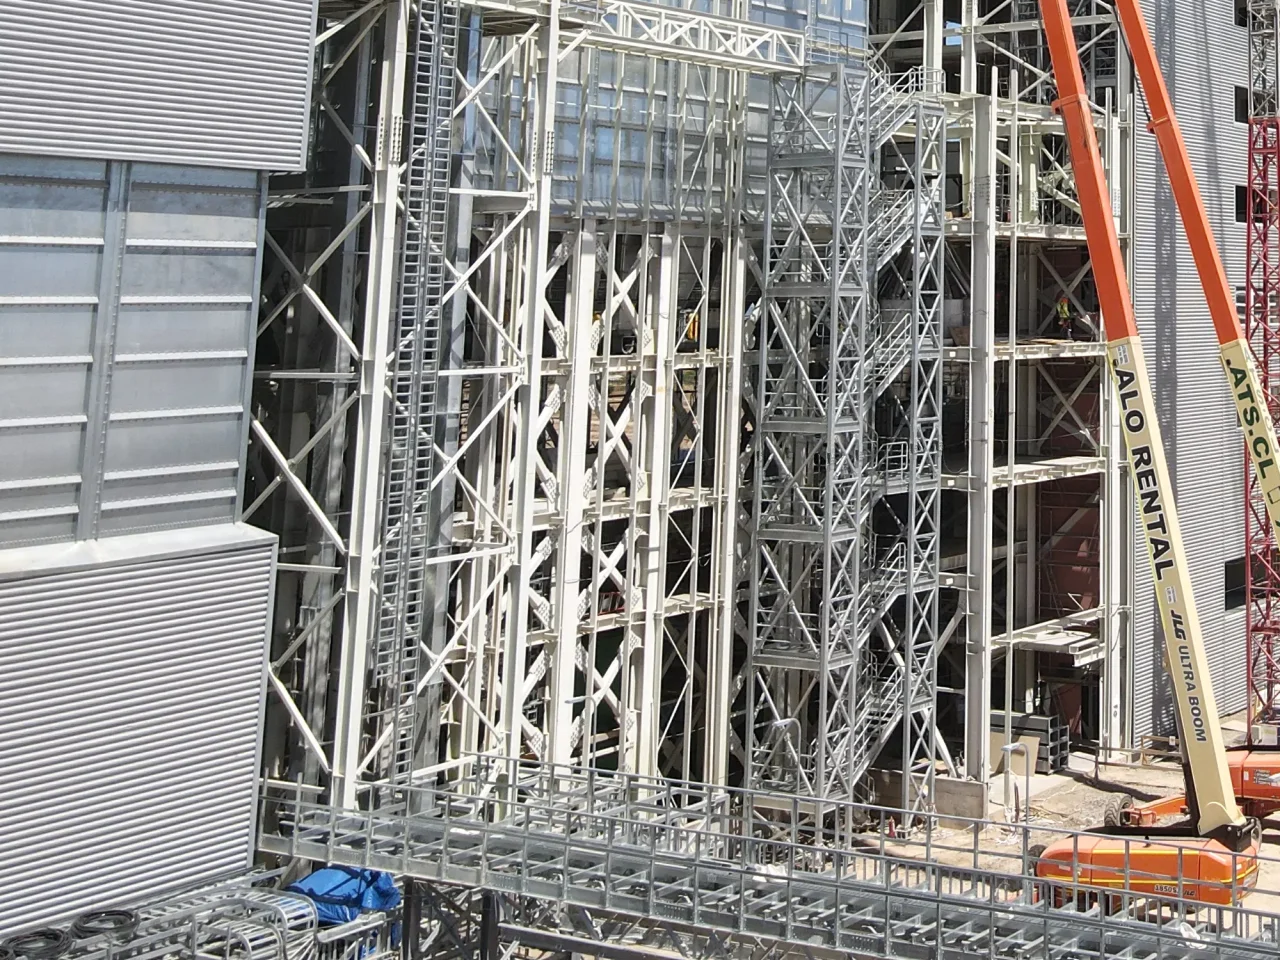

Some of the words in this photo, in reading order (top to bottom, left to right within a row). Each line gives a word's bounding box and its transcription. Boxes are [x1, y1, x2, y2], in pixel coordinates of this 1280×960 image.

[1229, 367, 1274, 479] ATS.CL
[1114, 368, 1145, 434] ALO
[1131, 444, 1175, 581] RENTAL
[1170, 609, 1187, 641] JLG
[1178, 645, 1196, 692] ULTRA
[1188, 696, 1207, 742] BOOM
